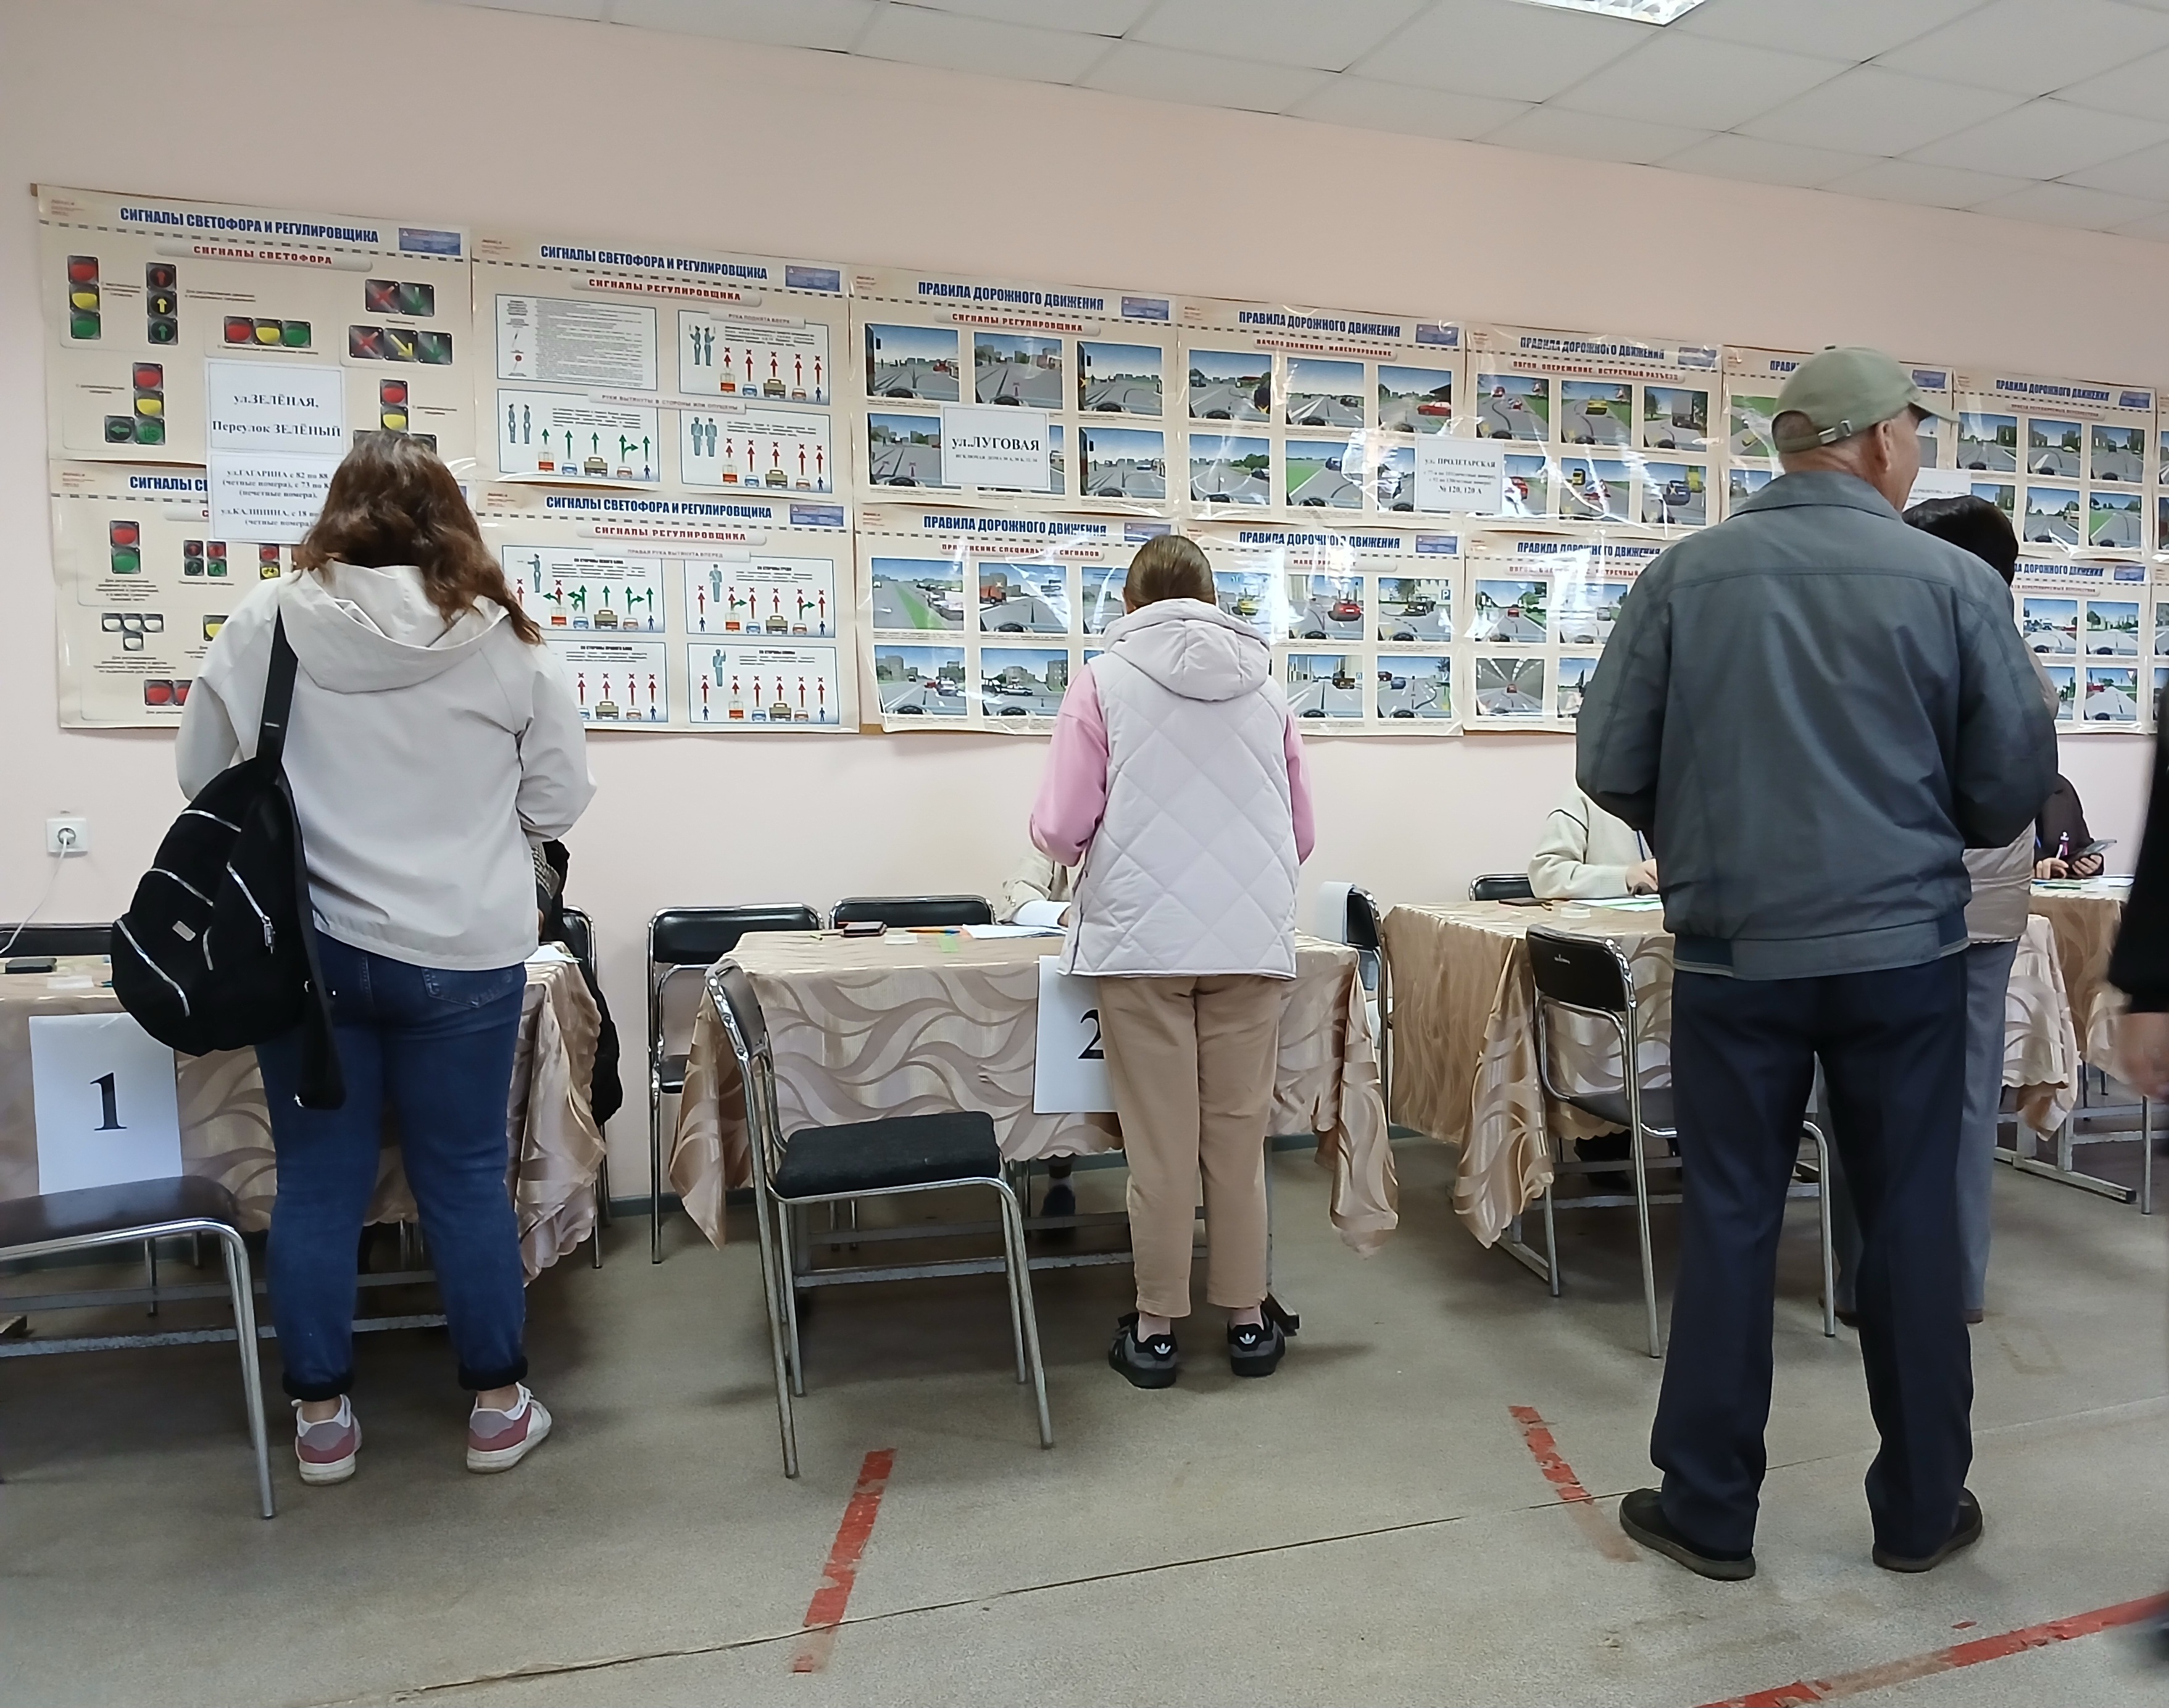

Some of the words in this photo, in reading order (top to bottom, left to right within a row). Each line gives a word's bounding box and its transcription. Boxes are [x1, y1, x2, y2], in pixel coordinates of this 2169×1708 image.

[120, 207, 184, 225] СИГНАЛЫ
[187, 214, 262, 232] СВЕТОФОРА
[264, 221, 272, 233] И
[275, 222, 379, 243] РЕГУЛИРОВЩИКА
[194, 246, 254, 257] СИГНАЛЫ
[259, 251, 332, 264] СВЕТОФОРА
[541, 246, 596, 262] СИГНАЛЫ
[598, 251, 665, 269] СВЕТОФОРА
[667, 258, 674, 269] И
[677, 259, 767, 279] РЕГУЛИРОВЩИКА
[589, 279, 643, 291] СИГНАЛЫ
[647, 285, 741, 301] РЕГУЛИРОВЩИКА
[918, 281, 971, 298] ПРАВИЛА
[973, 287, 1042, 304] ДОРОЖНОГО
[1044, 294, 1104, 310] ДВИЖЕНИЯ
[952, 313, 999, 324] СИГНАЛЫ
[1002, 318, 1083, 331] РЕГУЛИРОВЩИКА
[1239, 311, 1286, 326] ПРАВИЛА
[1287, 315, 1346, 332] ДОРОЖНОГО
[1347, 322, 1401, 338] ДВИЖЕНИЯ
[1520, 336, 1560, 351] ПРАВИЛА
[1562, 341, 1617, 355] ДОРОЖНОГО
[1618, 345, 1664, 360] ДВИЖЕНИЯ
[1770, 360, 1800, 372] ПРАВИ
[1996, 380, 2027, 392] ПРАВИЛА
[2029, 383, 2071, 397] ДОРОЖНОГО
[213, 420, 270, 434] Переулок
[273, 423, 340, 436] ЗЕЛЁНЫЙ
[952, 436, 1039, 451] ул.ЛУГОВАЯ
[1438, 458, 1496, 468] ПРОЛЕТАРСКАЯ
[130, 476, 192, 491] СИГНАЛЫ
[546, 496, 601, 510] СИГНАЛЫ
[604, 499, 670, 514] СВЕТОФОРА
[672, 503, 679, 514] И
[681, 503, 772, 519] РЕГУЛИРОВЩИКА
[923, 516, 975, 530] ПРАВИЛА
[977, 519, 1046, 533] ДОРОЖНОГО
[595, 527, 648, 536] СИГНАЛЫ
[652, 530, 746, 541] РЕГУЛИРОВЩИКА
[1239, 531, 1284, 544] ПРАВИЛА
[1349, 536, 1401, 549] ДВИЖЕНИЯ
[1518, 542, 1557, 554] ПРАВИЛА
[2024, 564, 2068, 574] ДОРОЖНОГО
[1077, 1009, 1104, 1060] 2
[90, 1072, 127, 1131] 1
